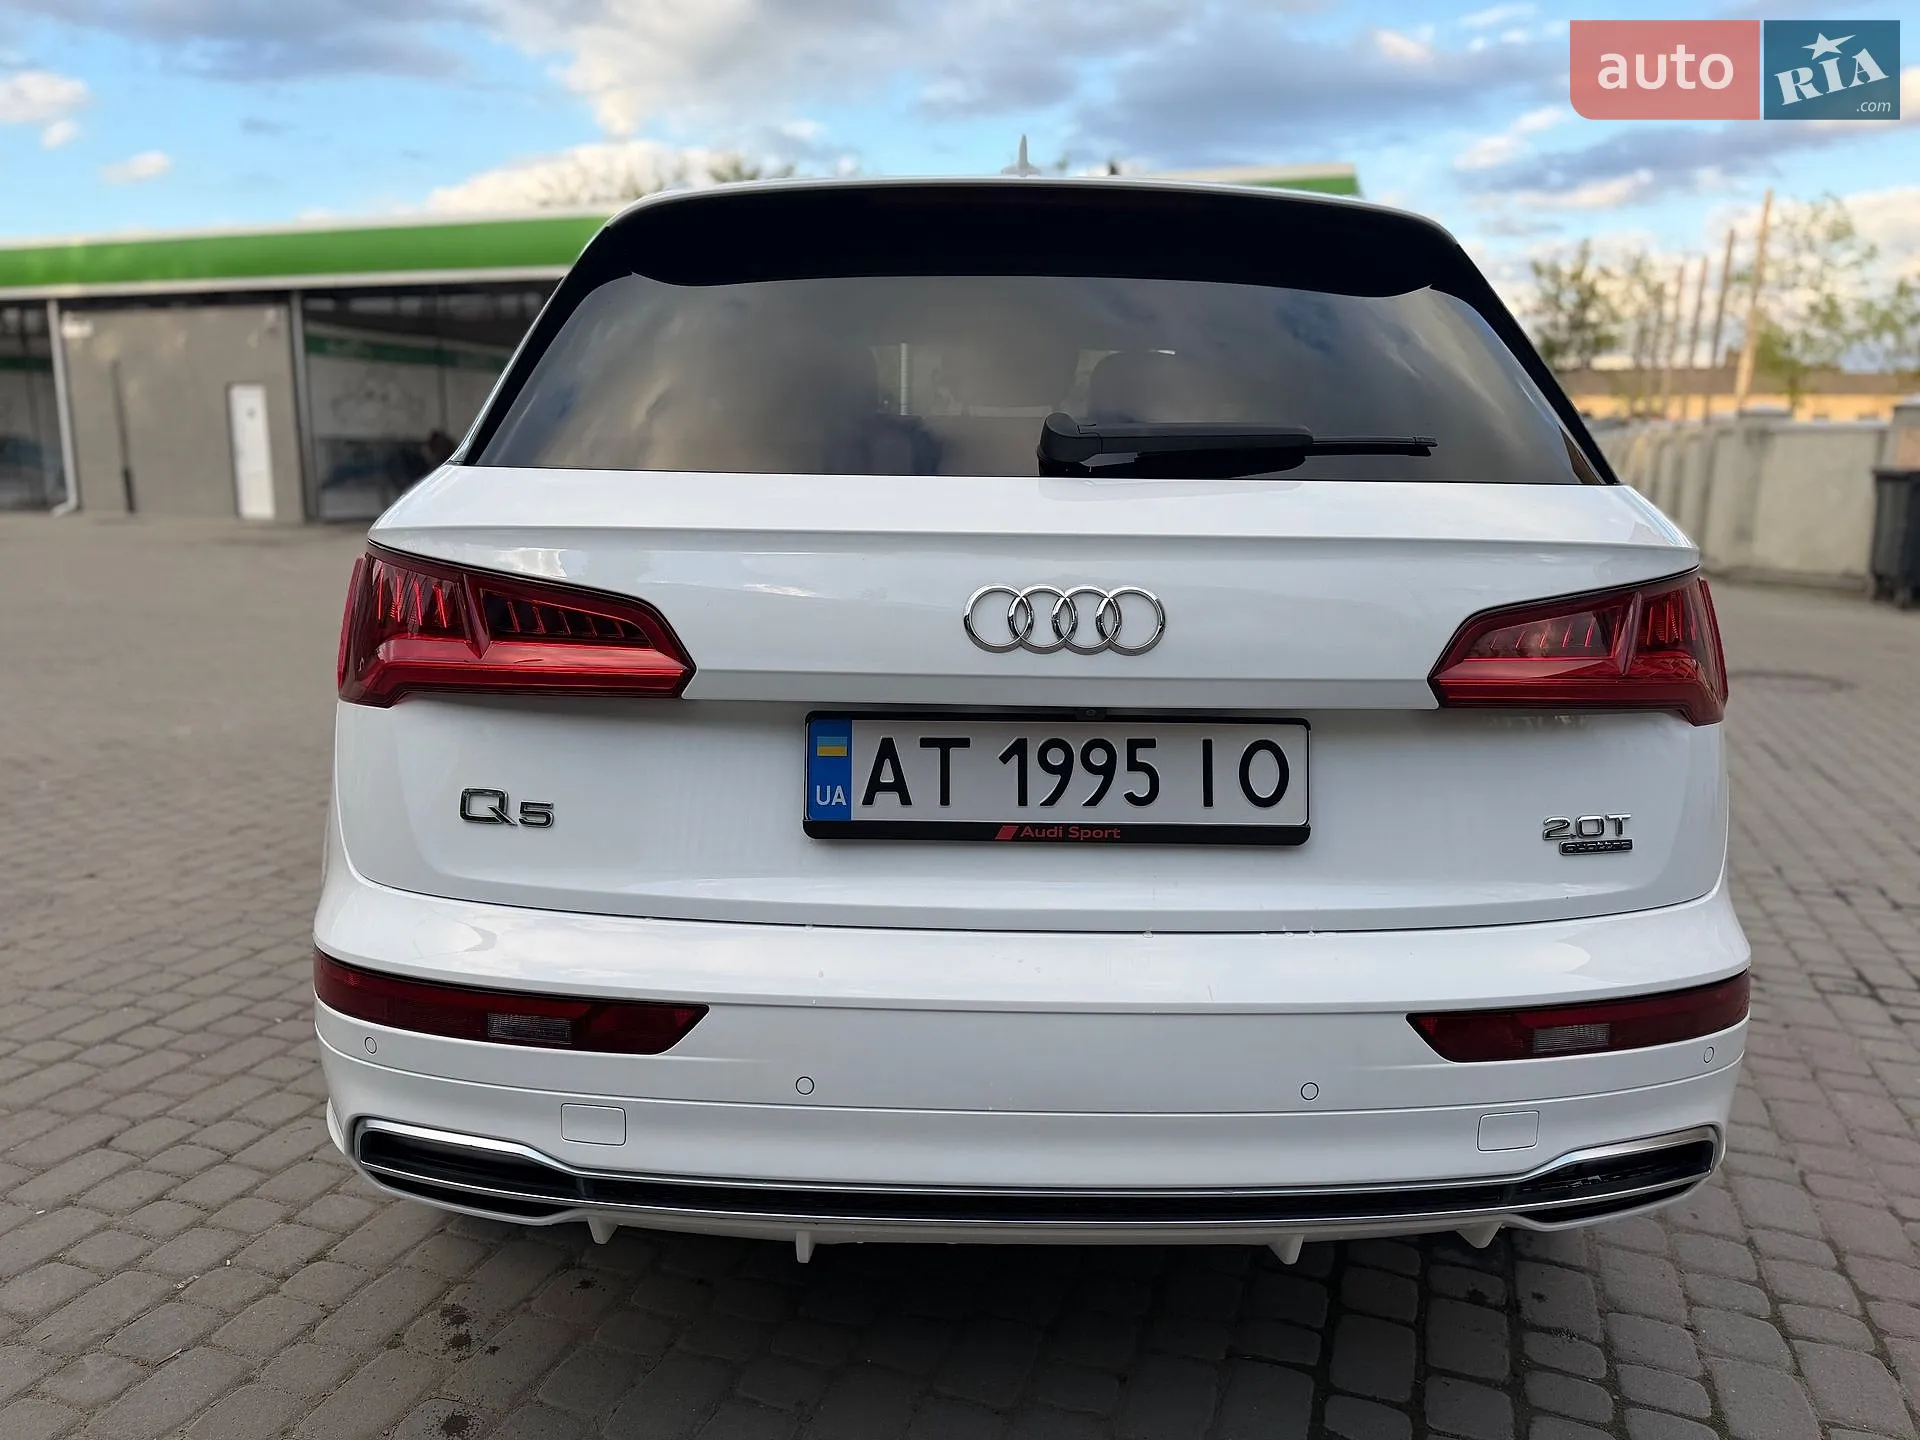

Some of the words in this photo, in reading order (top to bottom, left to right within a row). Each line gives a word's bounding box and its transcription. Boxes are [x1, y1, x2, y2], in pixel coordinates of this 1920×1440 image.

[861, 736, 971, 807] AT
[997, 737, 1160, 808] 1995
[1201, 738, 1290, 808] IO
[459, 787, 554, 828] Q5
[815, 785, 847, 806] UA
[1020, 826, 1063, 839] Audi
[1067, 826, 1121, 841] Sport
